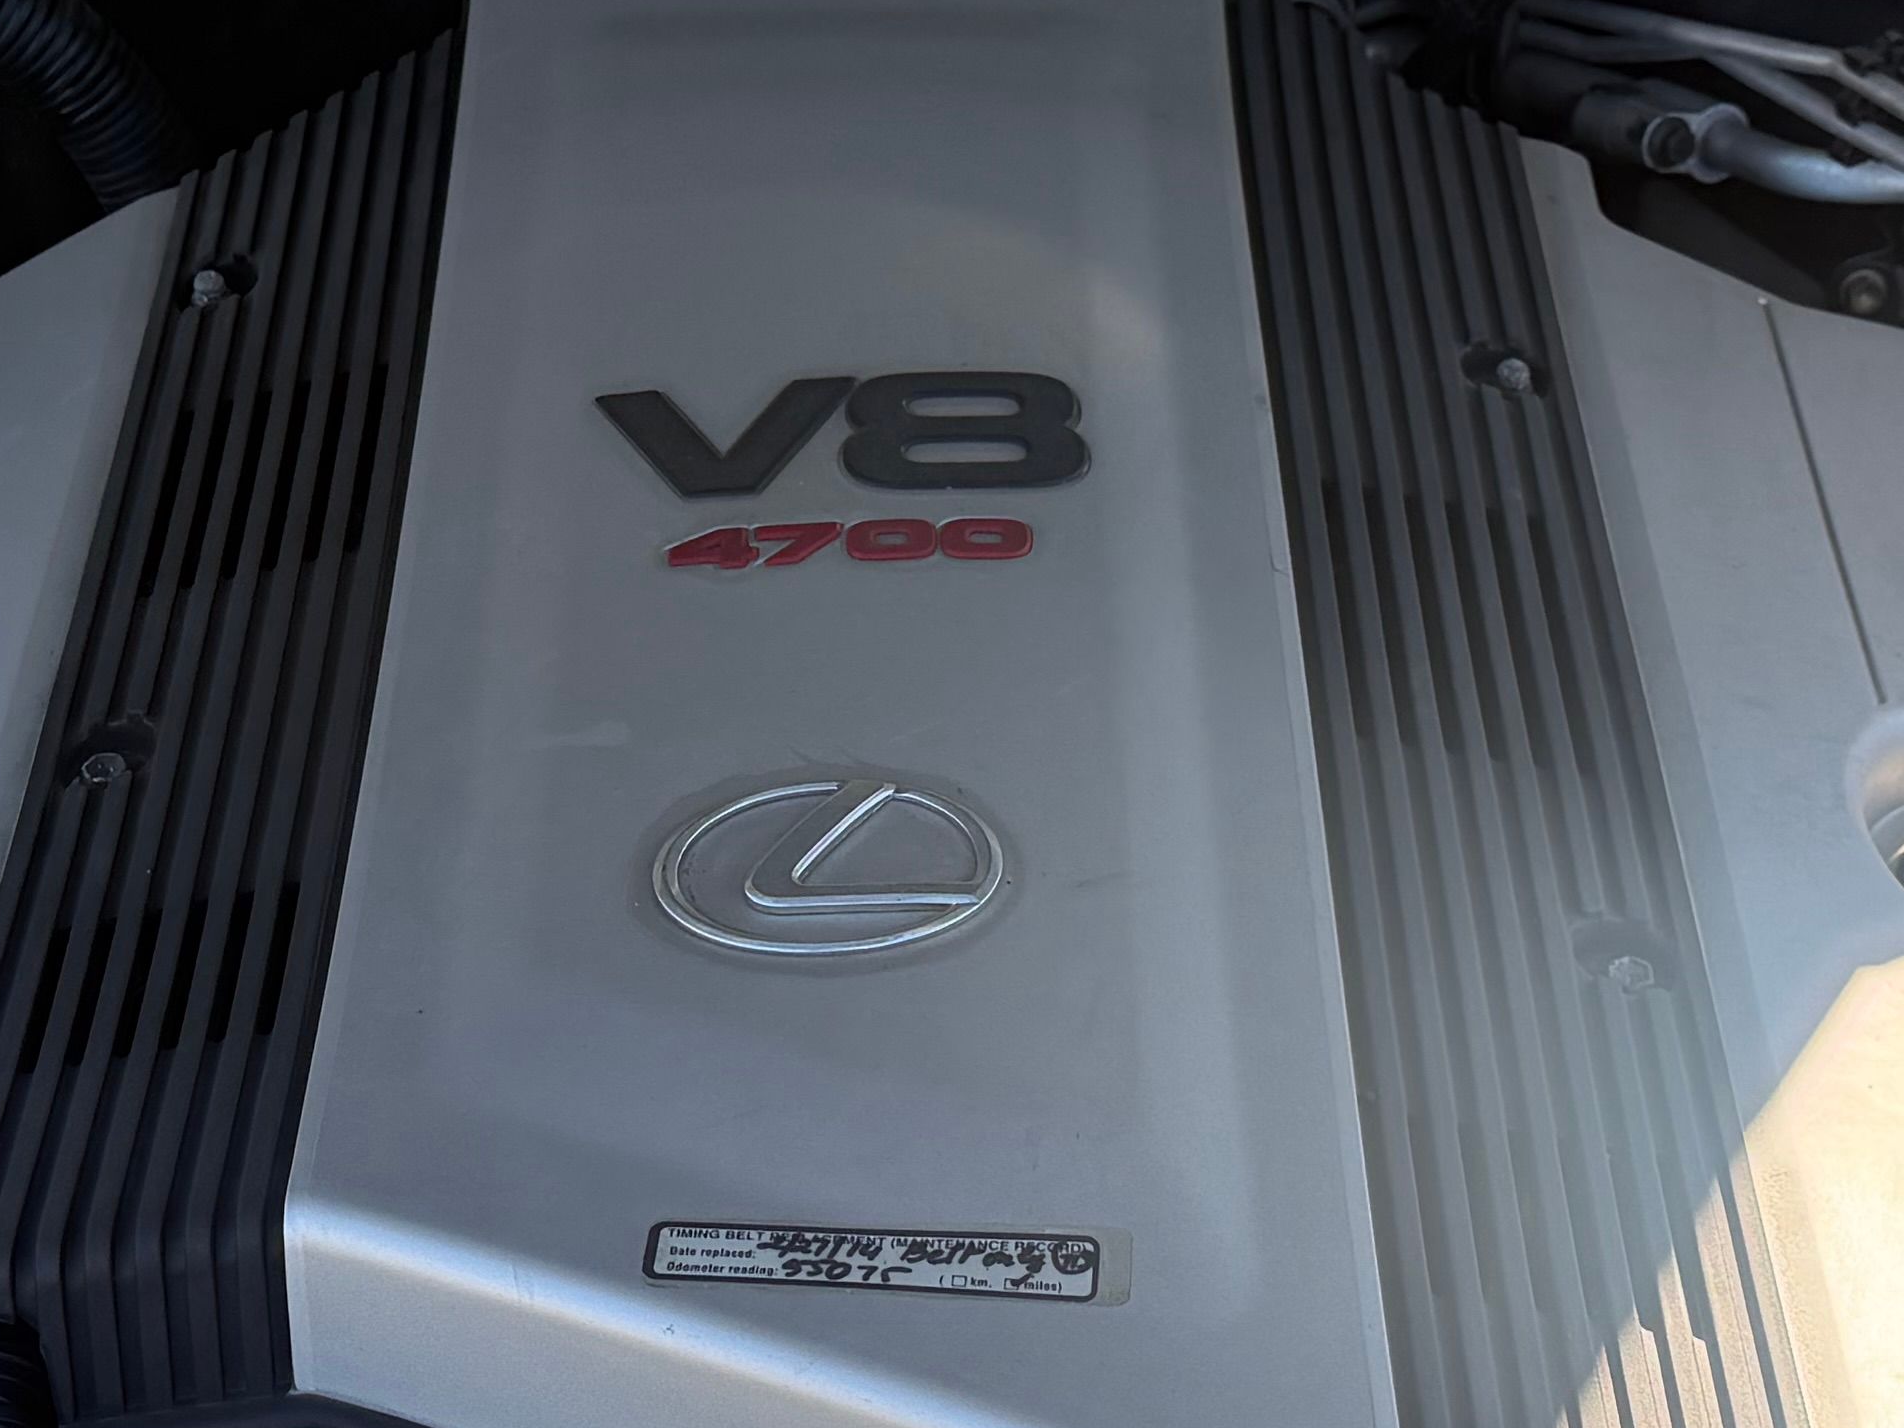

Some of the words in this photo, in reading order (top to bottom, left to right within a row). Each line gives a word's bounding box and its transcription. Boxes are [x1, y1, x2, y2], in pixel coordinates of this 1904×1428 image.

[595, 370, 1092, 500] V8
[661, 517, 1036, 570] 4700
[667, 1227, 720, 1240] TIMING
[725, 1230, 764, 1241] BELT
[669, 1245, 698, 1257] Date
[700, 1246, 757, 1259] replaced:
[666, 1261, 725, 1273] Odometer
[728, 1264, 779, 1277] reading:
